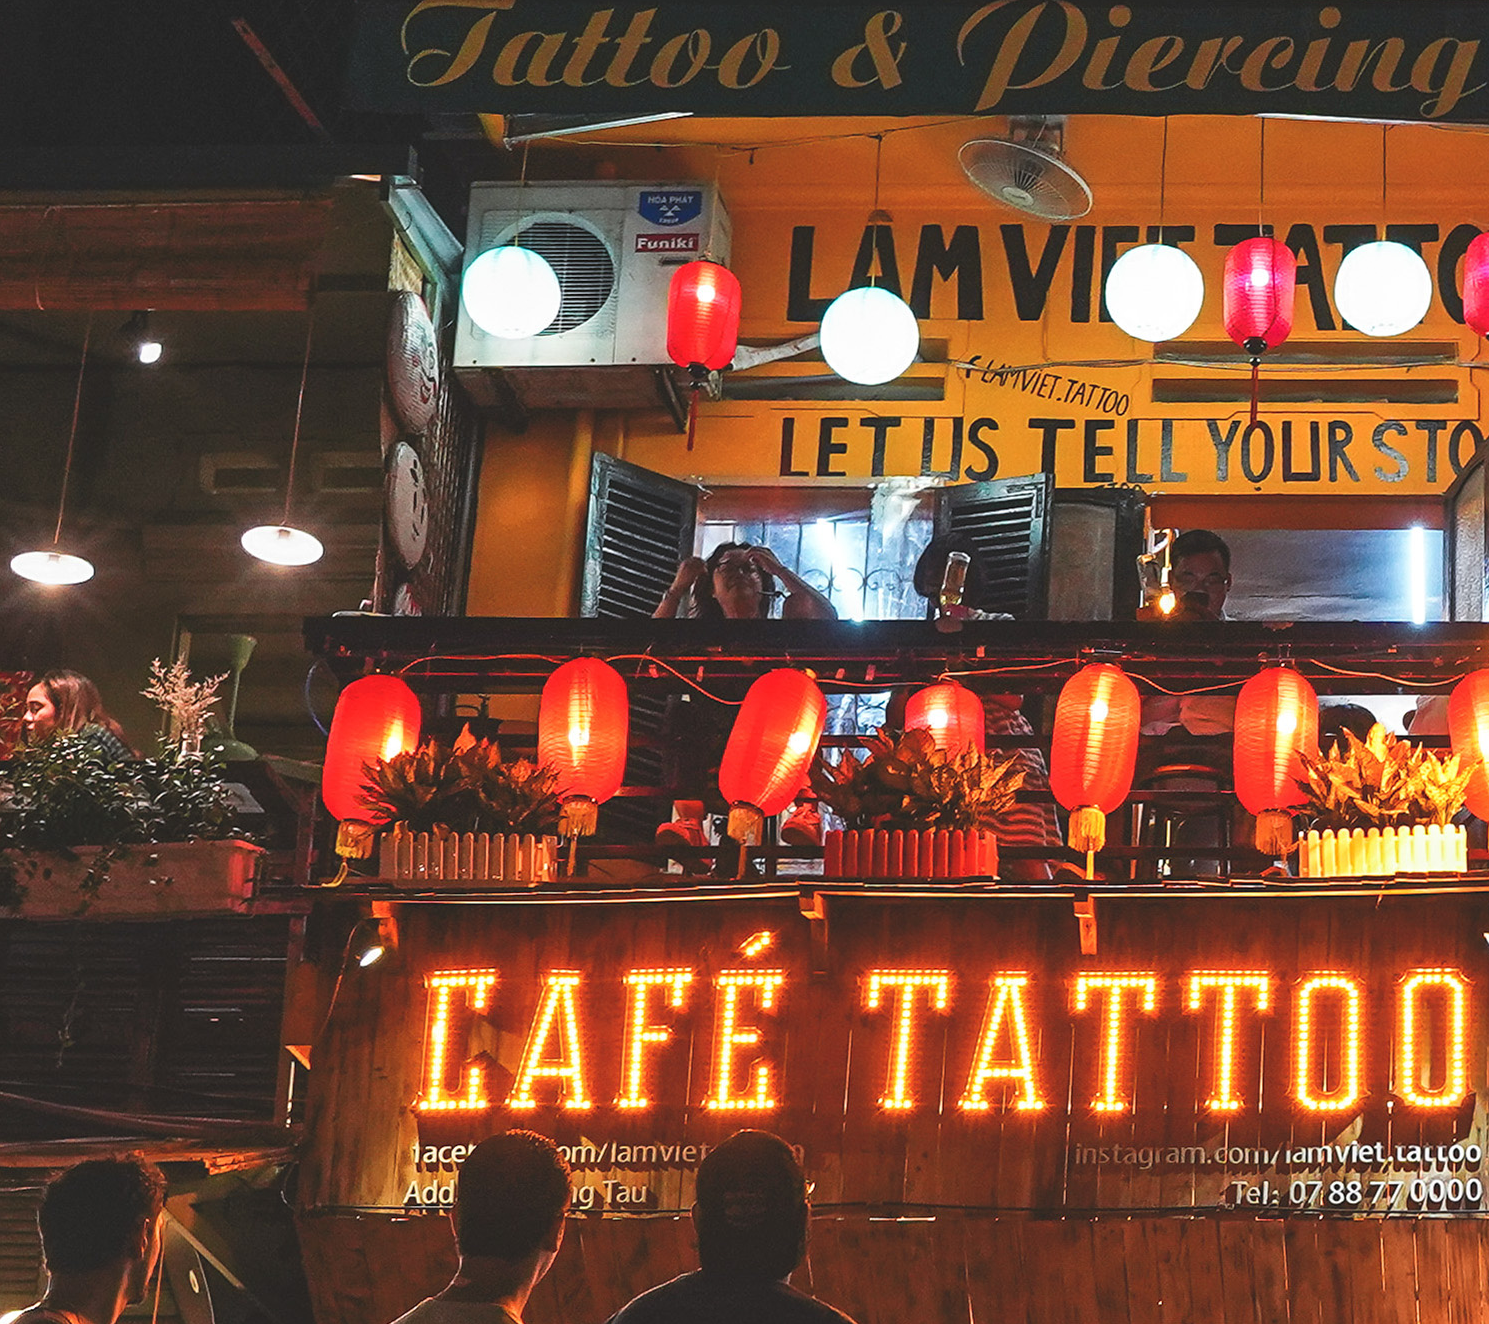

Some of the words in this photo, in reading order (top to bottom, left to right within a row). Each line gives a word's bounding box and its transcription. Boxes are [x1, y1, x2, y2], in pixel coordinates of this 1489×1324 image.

[831, 10, 907, 91] &
[637, 237, 694, 250] Funiki
[779, 417, 902, 477] LET
[922, 416, 1000, 482] US
[1028, 418, 1188, 483] TELL
[1206, 419, 1361, 483] YOUR
[411, 930, 789, 1111] CAFÉ
[861, 968, 1473, 1111] TATTOO
